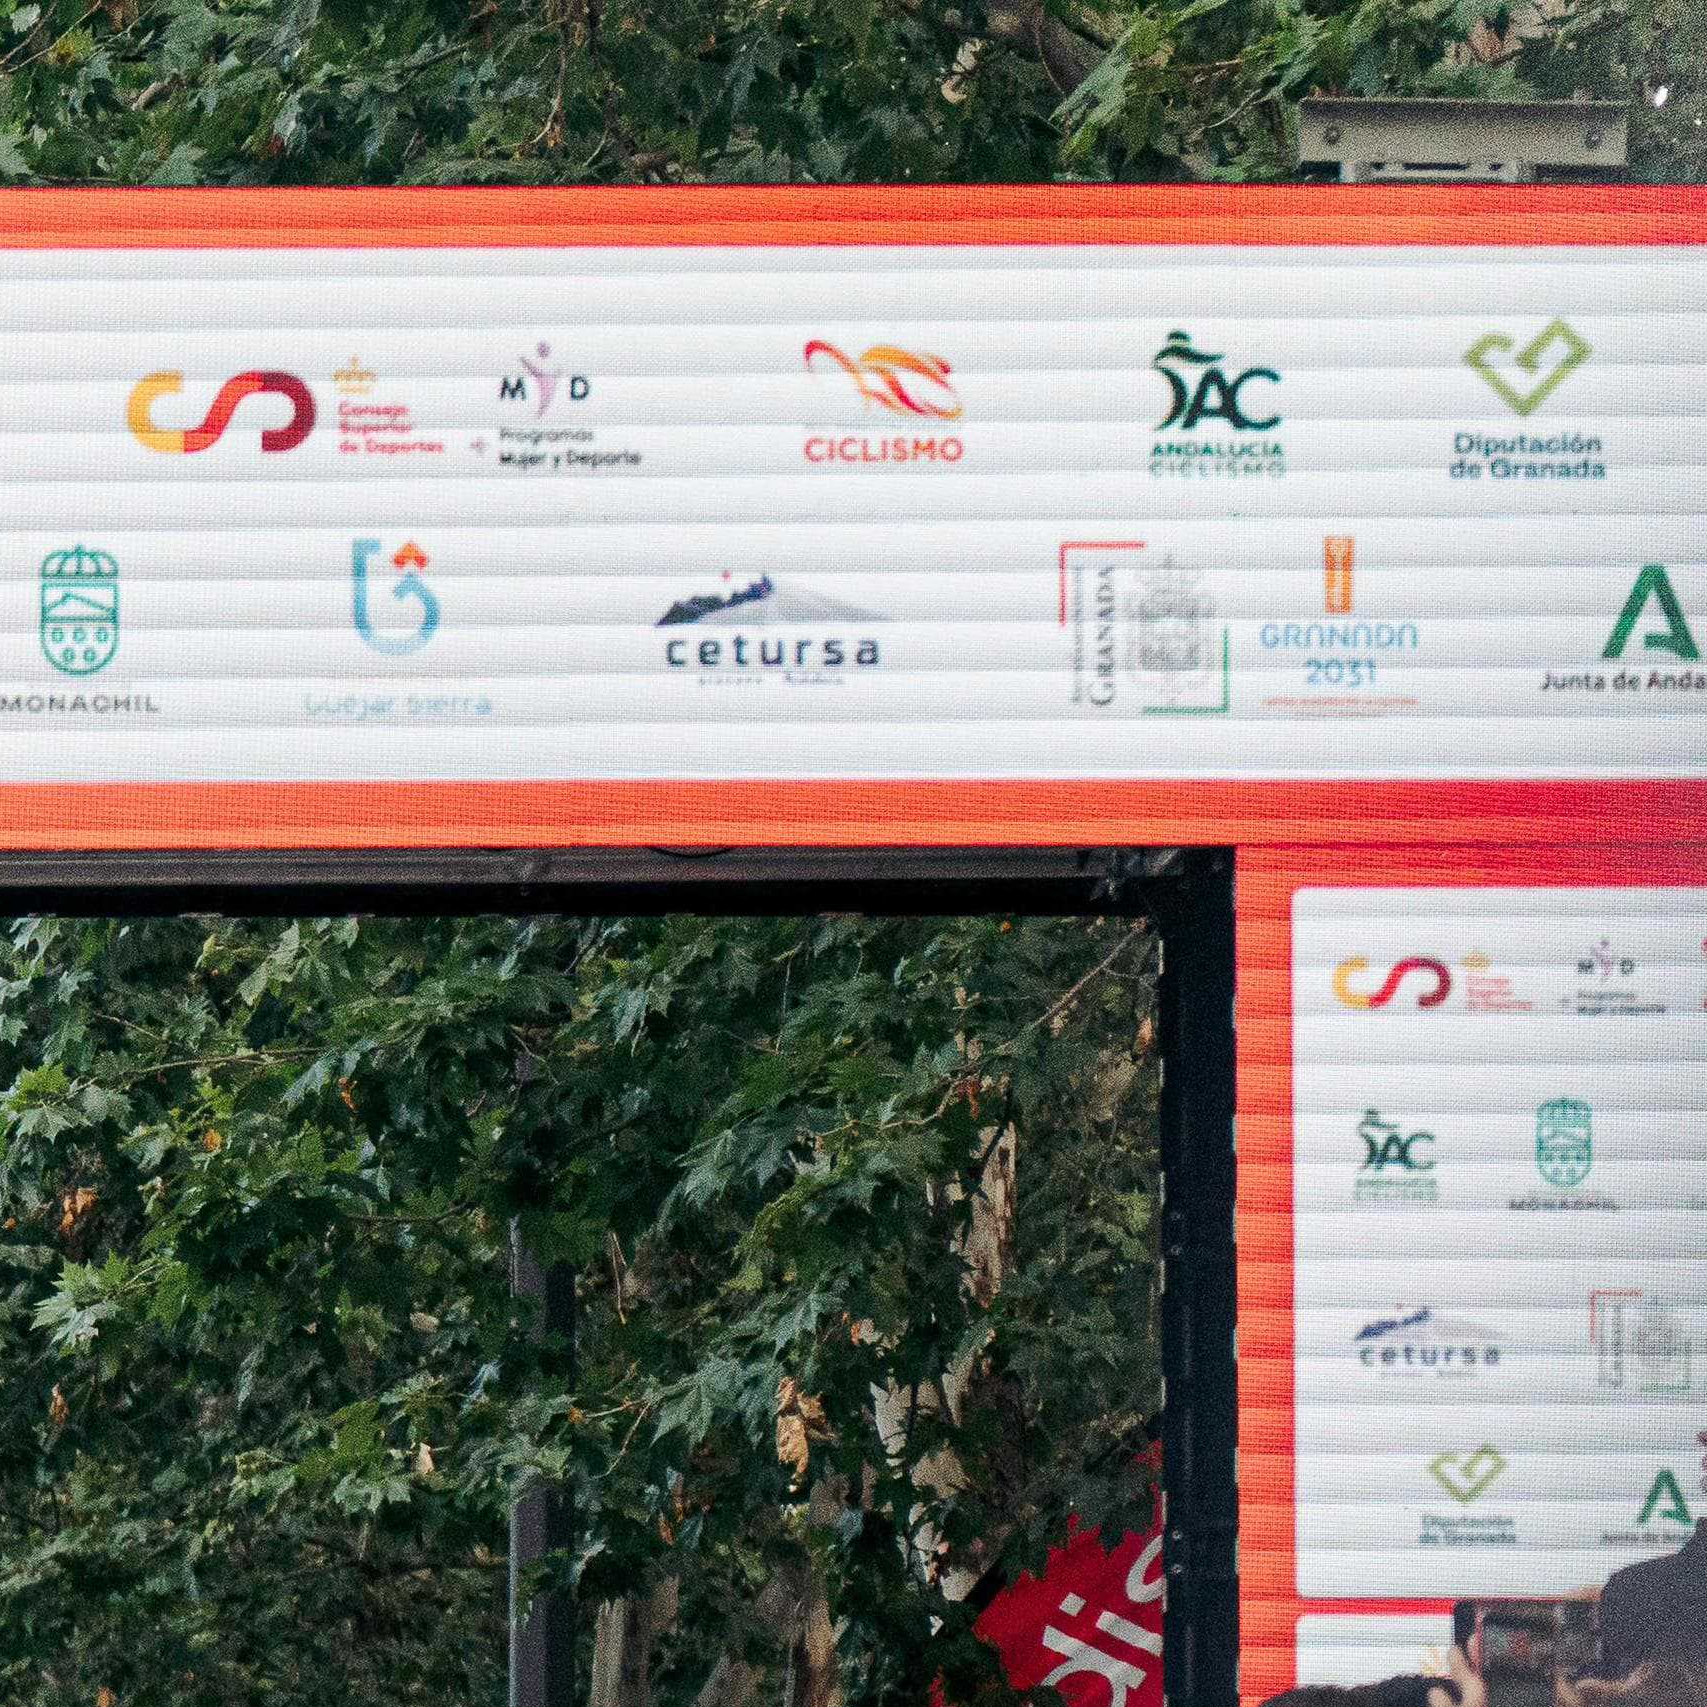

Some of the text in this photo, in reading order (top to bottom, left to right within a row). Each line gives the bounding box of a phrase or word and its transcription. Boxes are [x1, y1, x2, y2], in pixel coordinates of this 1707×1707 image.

[804, 438, 964, 463] CICLISMO
[1454, 433, 1602, 457] Diputación
[1149, 460, 1286, 479] CICLISMO
[1449, 458, 1607, 480] de Granada
[665, 634, 881, 668] cetursa
[1306, 657, 1377, 688] 2031
[1541, 671, 1607, 690] Junta
[1612, 670, 1641, 690] de
